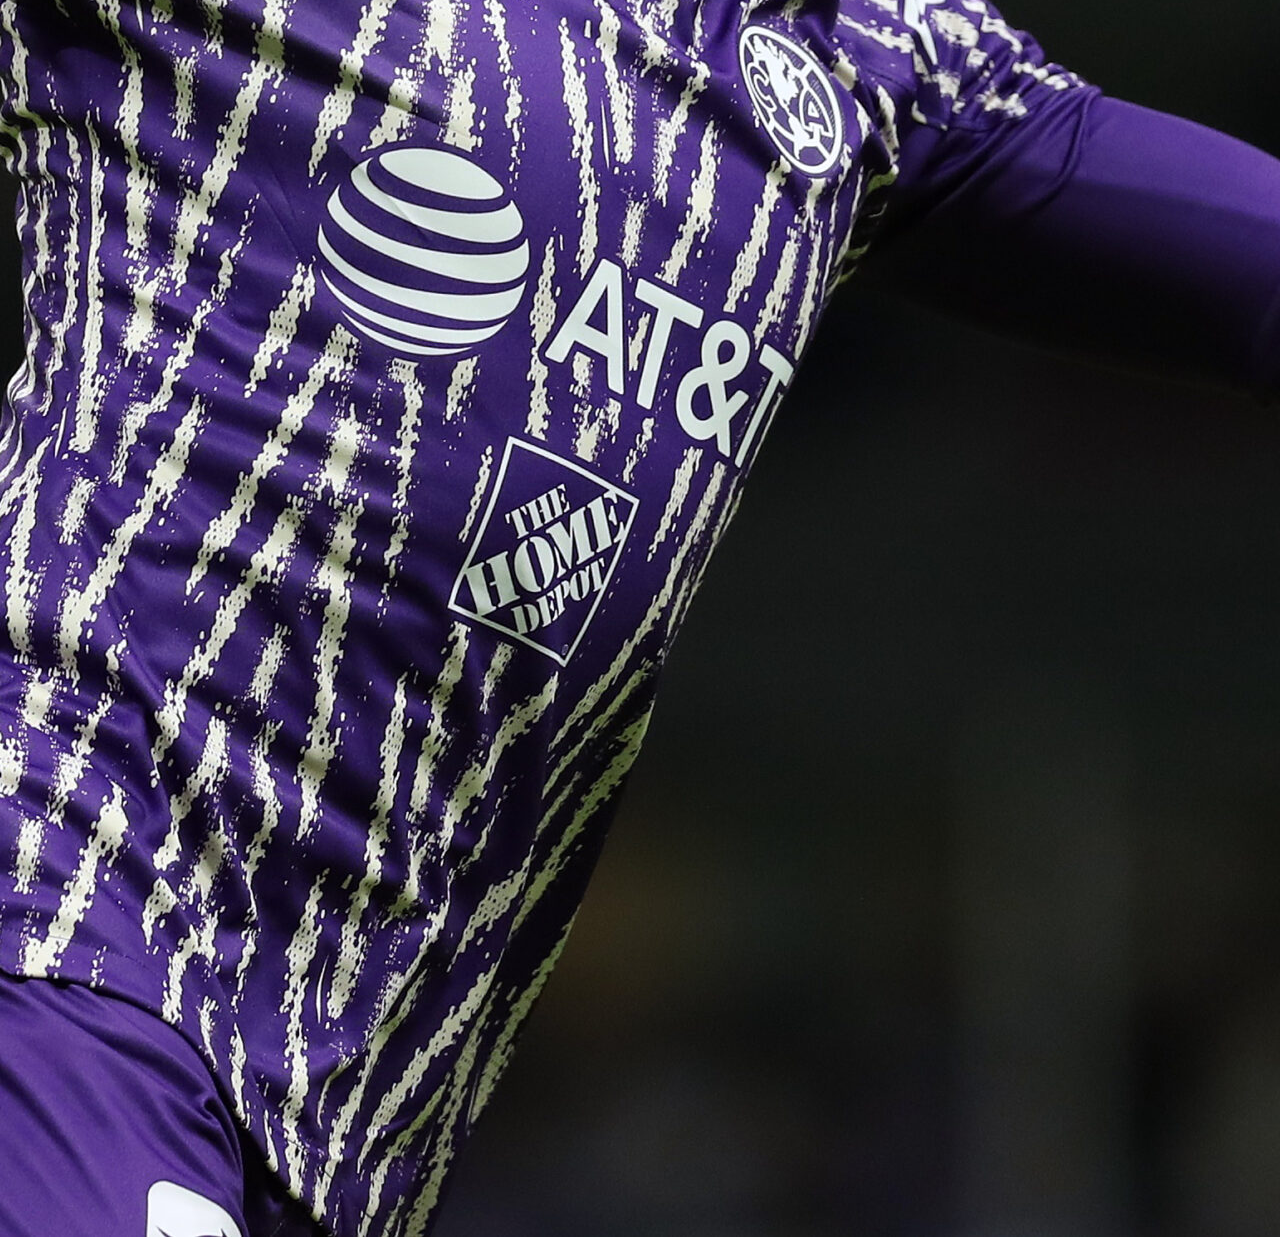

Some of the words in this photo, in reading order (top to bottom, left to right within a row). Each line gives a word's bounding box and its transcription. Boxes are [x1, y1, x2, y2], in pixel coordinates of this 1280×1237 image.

[544, 257, 795, 468] AT&T
[464, 488, 626, 617] HOME
[504, 483, 571, 540] THE
[510, 557, 605, 635] DEPOT
